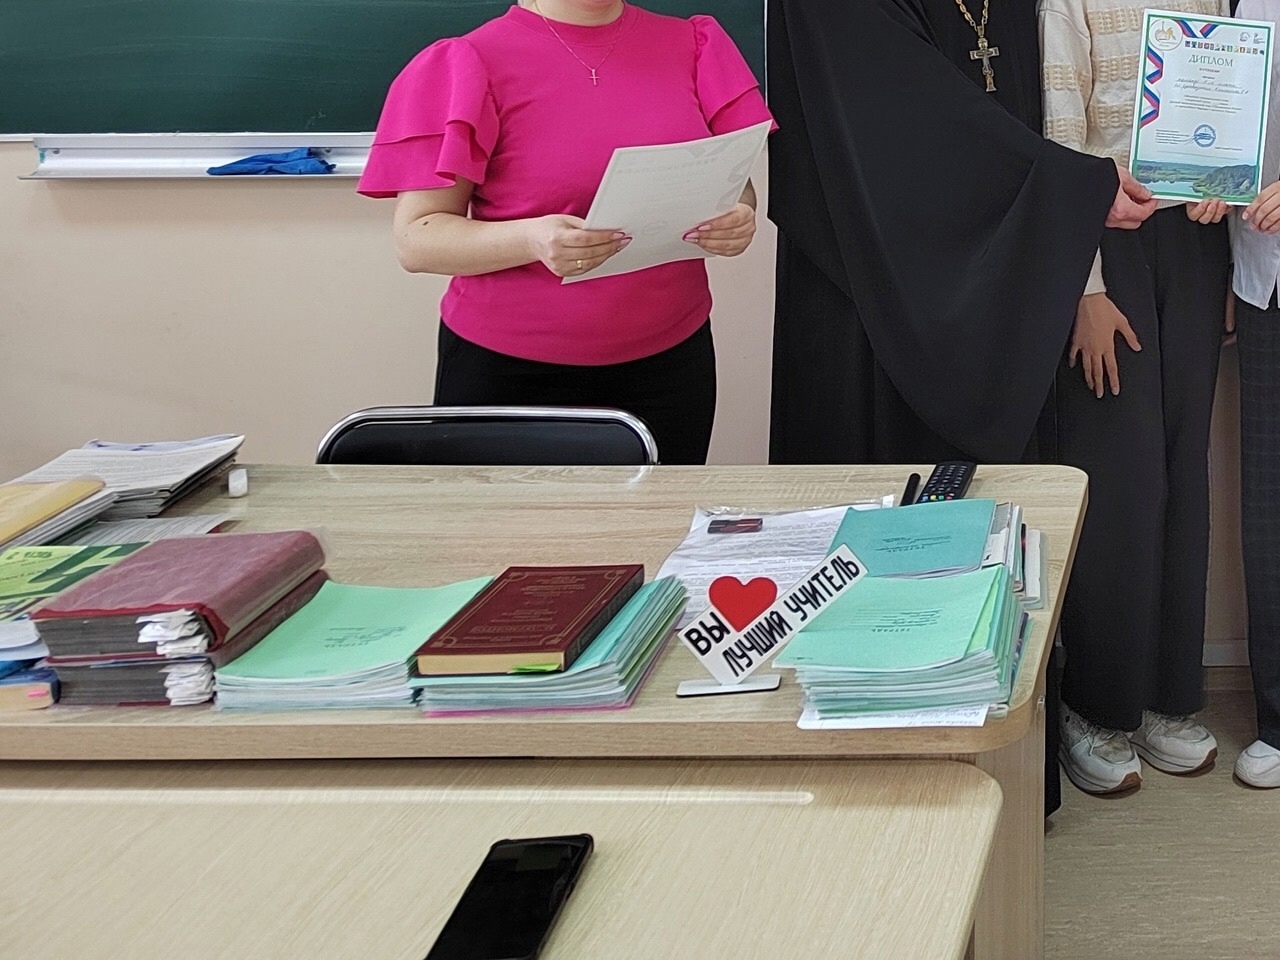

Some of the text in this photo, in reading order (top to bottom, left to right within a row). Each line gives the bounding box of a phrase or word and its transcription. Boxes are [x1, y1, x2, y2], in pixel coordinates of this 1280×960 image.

[1188, 54, 1234, 67] ДИПЛОМ
[684, 613, 730, 656] ВЫ
[722, 556, 860, 677] ЛУЧШИЙ УЧИТЕЛЬ
